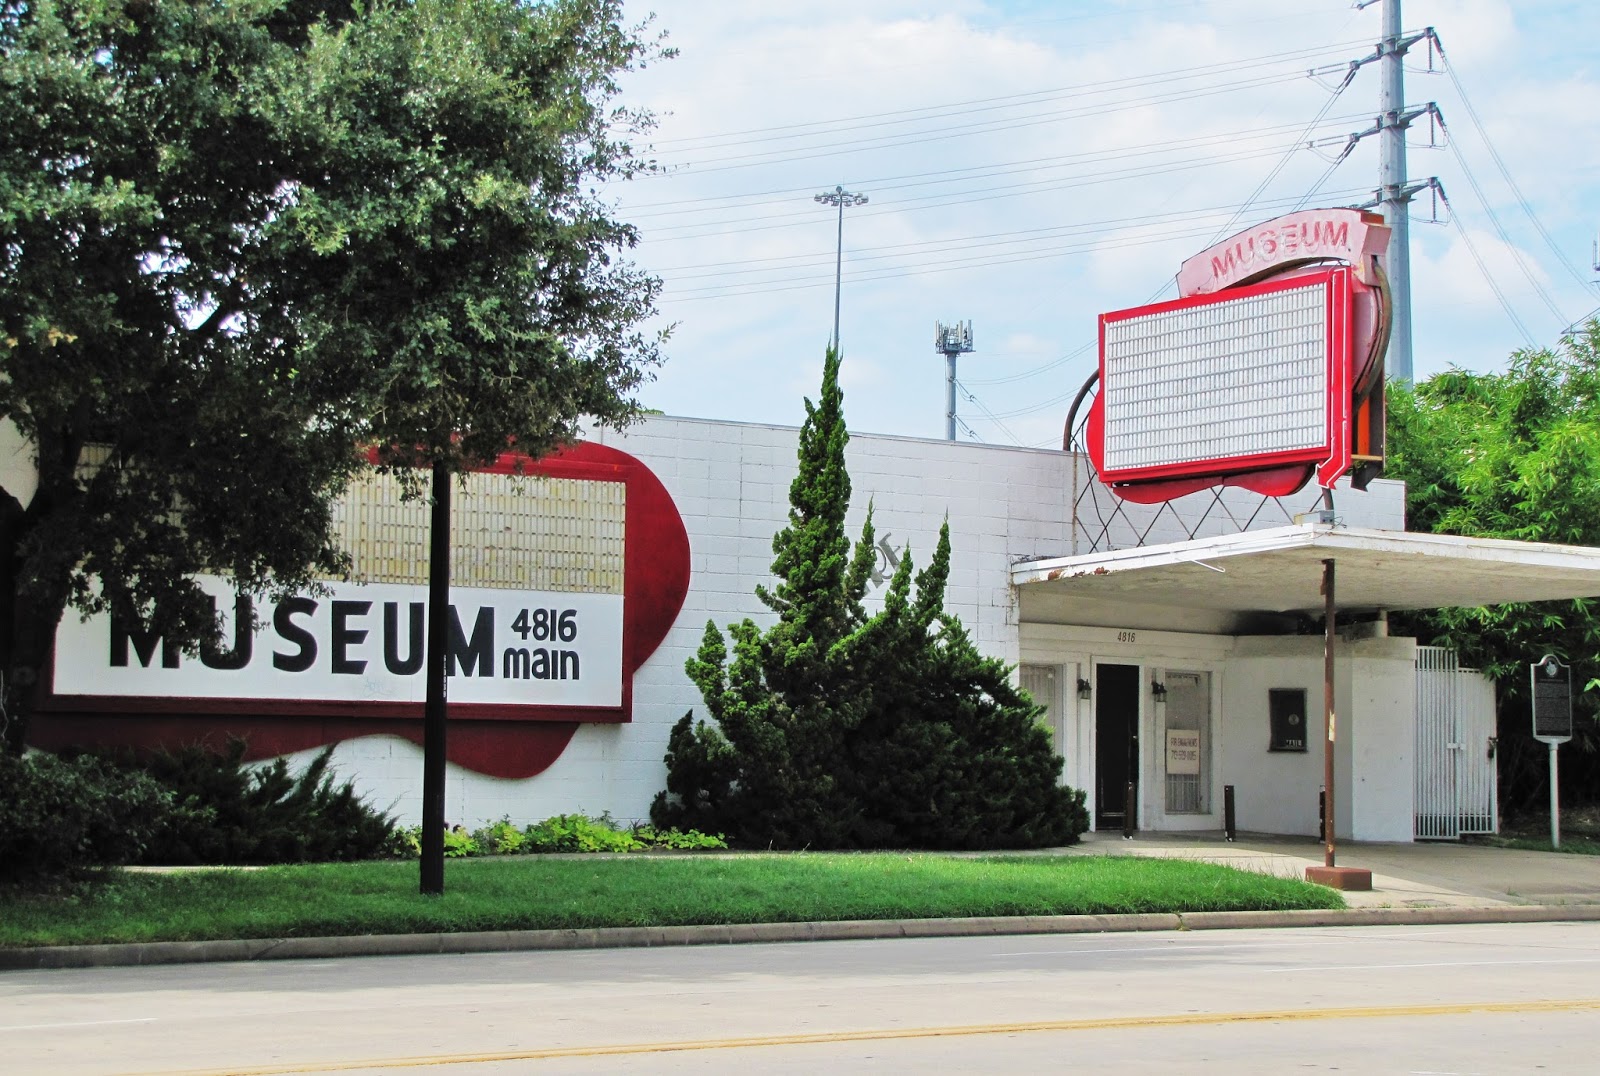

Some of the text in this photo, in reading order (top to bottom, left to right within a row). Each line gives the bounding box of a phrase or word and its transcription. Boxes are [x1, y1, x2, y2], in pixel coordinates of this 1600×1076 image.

[1211, 221, 1349, 279] MUSEUM
[110, 595, 494, 677] MUSEUM
[511, 608, 578, 643] 4816
[1117, 631, 1136, 643] 4816
[503, 647, 580, 681] main
